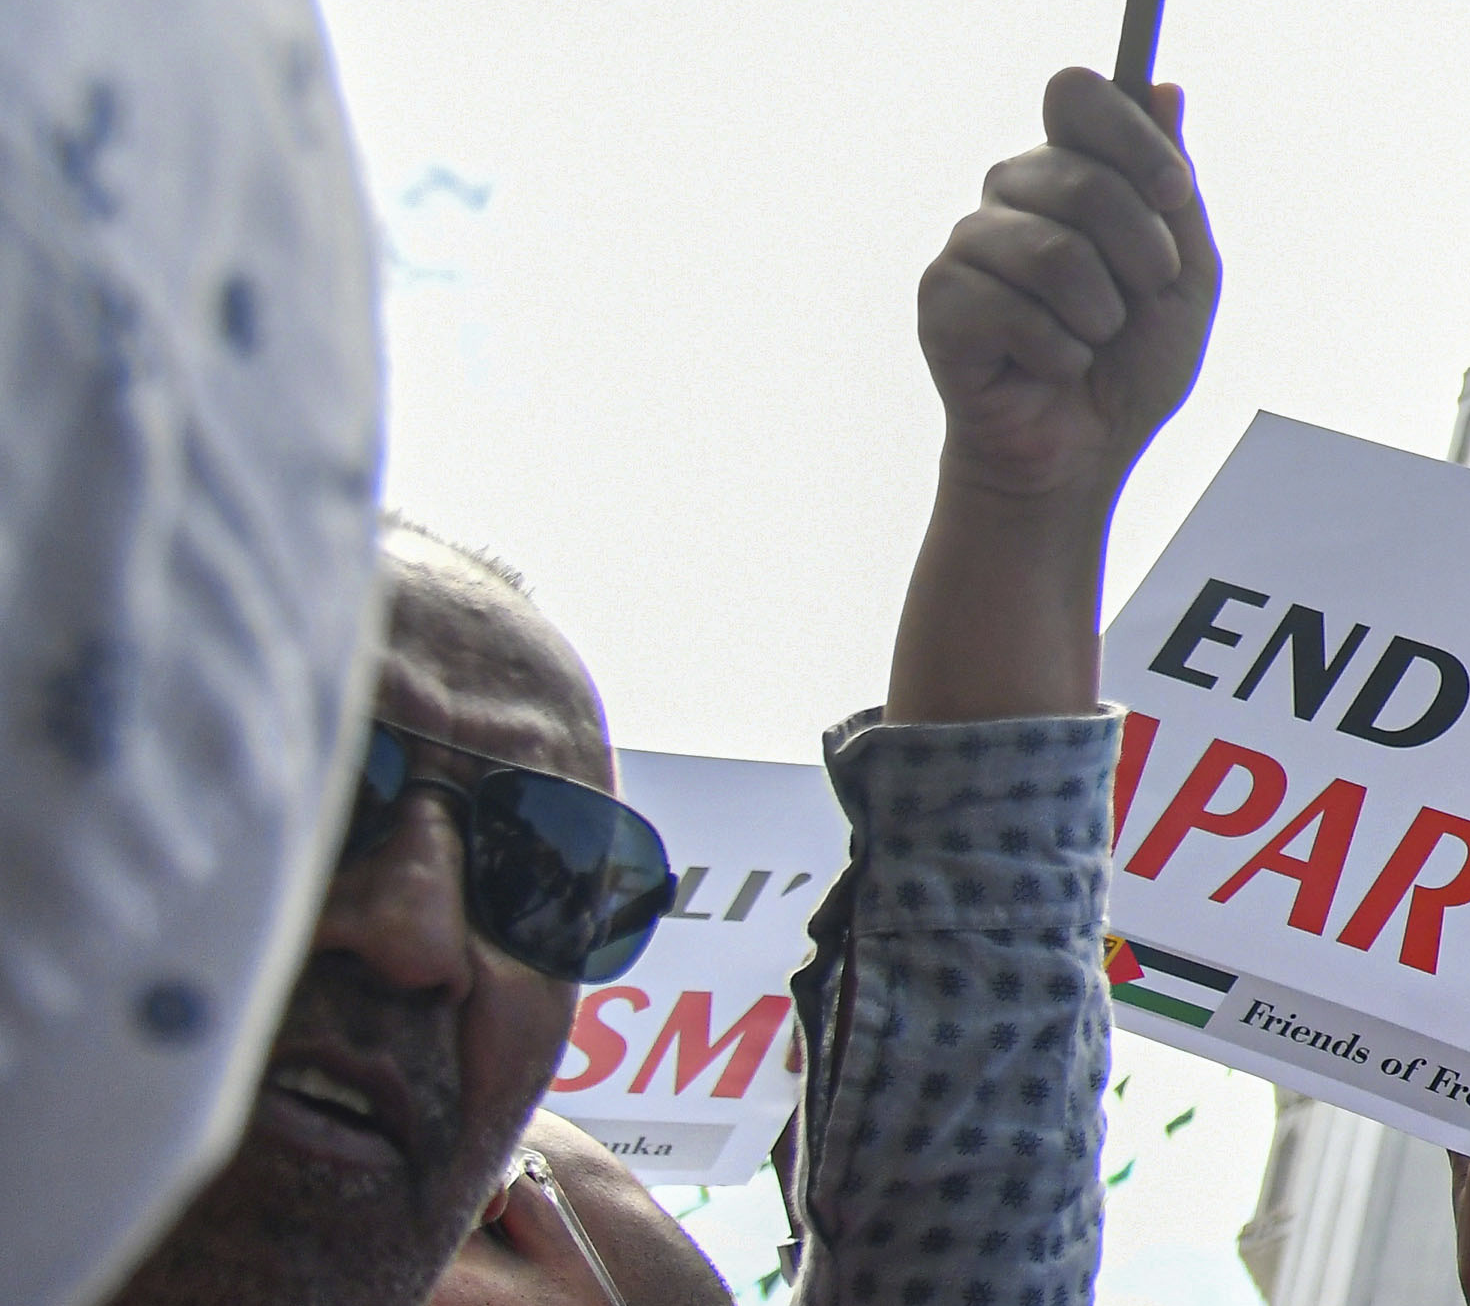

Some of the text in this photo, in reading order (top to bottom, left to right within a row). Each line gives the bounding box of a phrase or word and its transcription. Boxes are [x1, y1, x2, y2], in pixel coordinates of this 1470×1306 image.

[1148, 577, 1470, 749] END
[1239, 999, 1371, 1064] Friends
[1380, 1057, 1428, 1082] of
